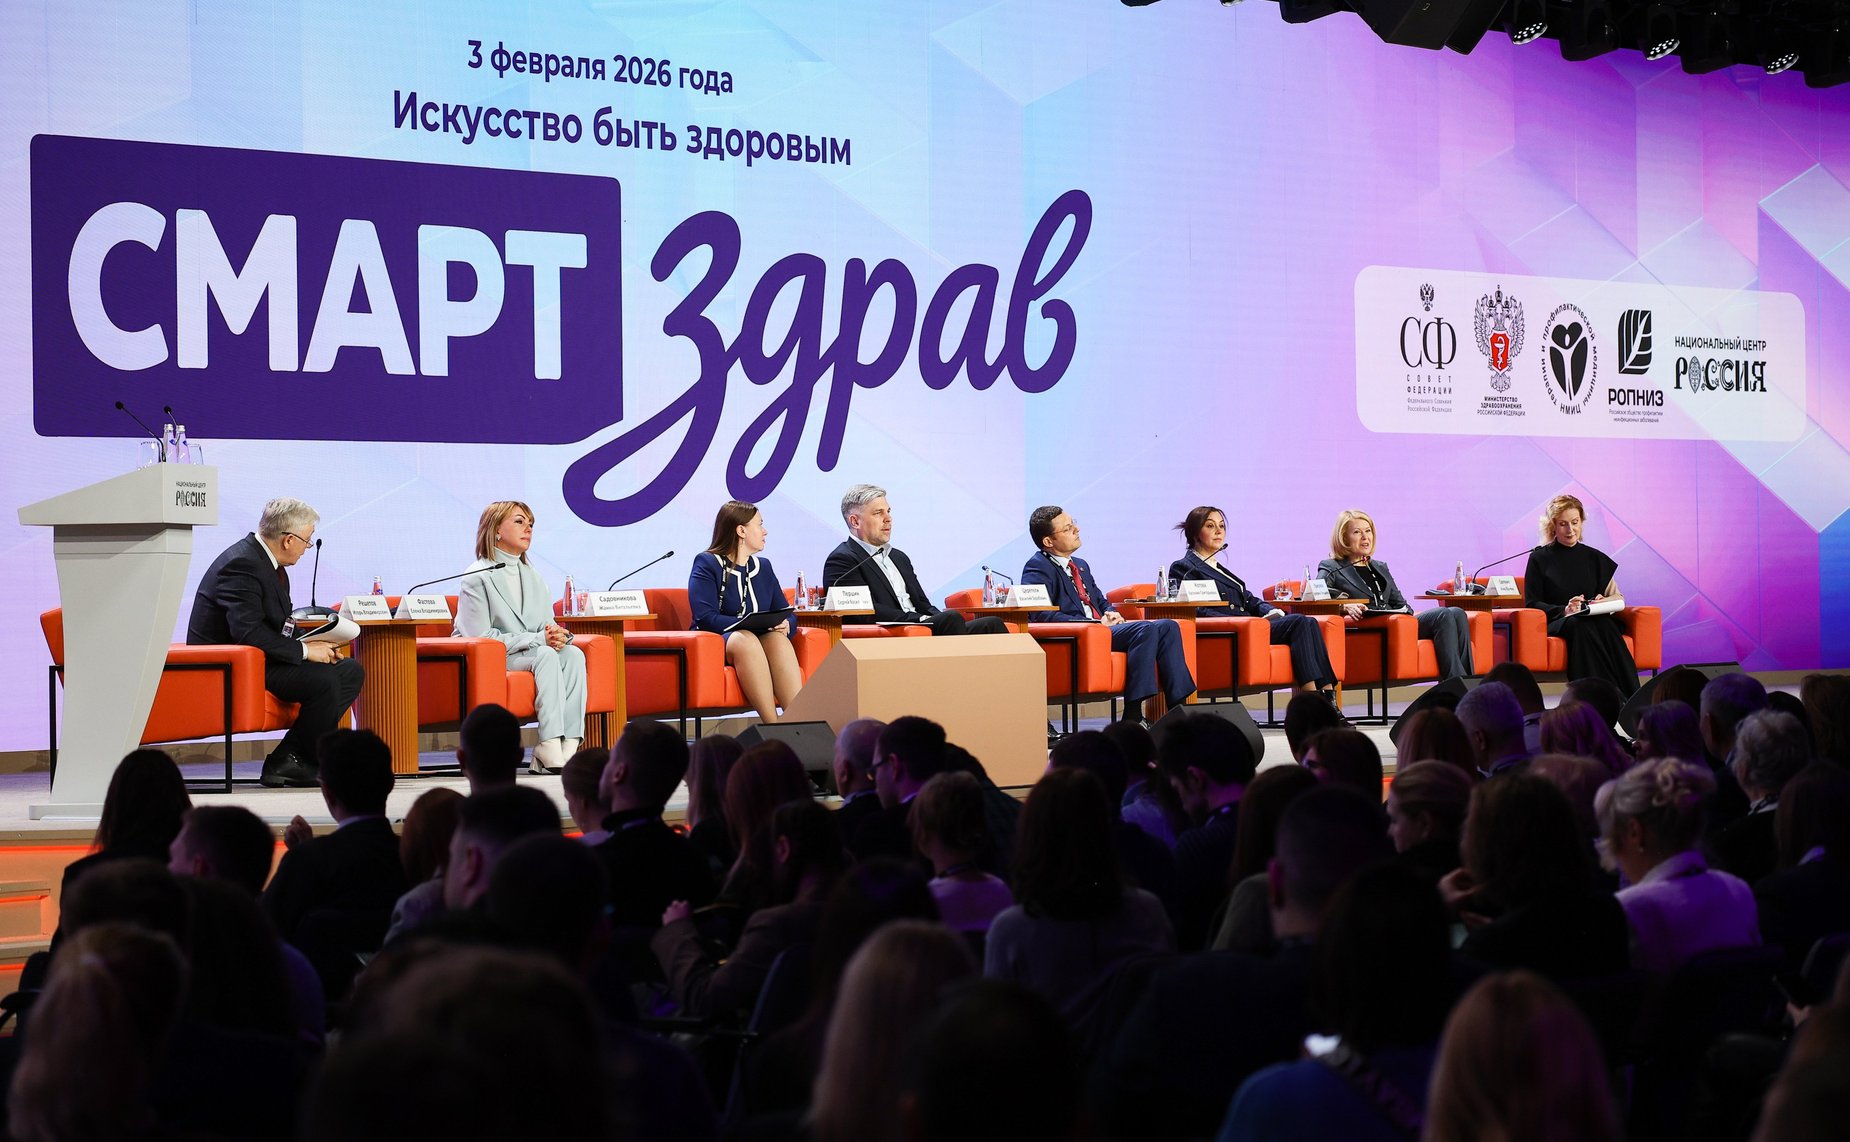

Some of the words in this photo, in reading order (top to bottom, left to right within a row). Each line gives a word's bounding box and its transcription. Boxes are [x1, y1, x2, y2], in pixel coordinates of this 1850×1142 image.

[467, 39, 483, 69] 3
[490, 41, 606, 83] февраля
[613, 54, 672, 88] 2026
[679, 67, 734, 97] года
[393, 89, 583, 147] Искусство
[593, 105, 678, 152] быть
[686, 124, 852, 168] здоровым
[68, 201, 588, 381] СМАРТ
[1542, 303, 1596, 342] профилактической
[1400, 316, 1457, 370] СФ
[1674, 336, 1742, 350] НАЦИОНАЛЬНЫЙ
[1742, 339, 1767, 352] ЦЕНТР
[1406, 374, 1452, 383] СОВЕТ
[1407, 386, 1453, 395] ФЕДЕРАЦИИ
[1582, 346, 1598, 407] медицины
[1674, 355, 1768, 394] РОССИЯ
[1560, 404, 1582, 415] НМИЦ
[1608, 388, 1664, 407] РОПНИЗ
